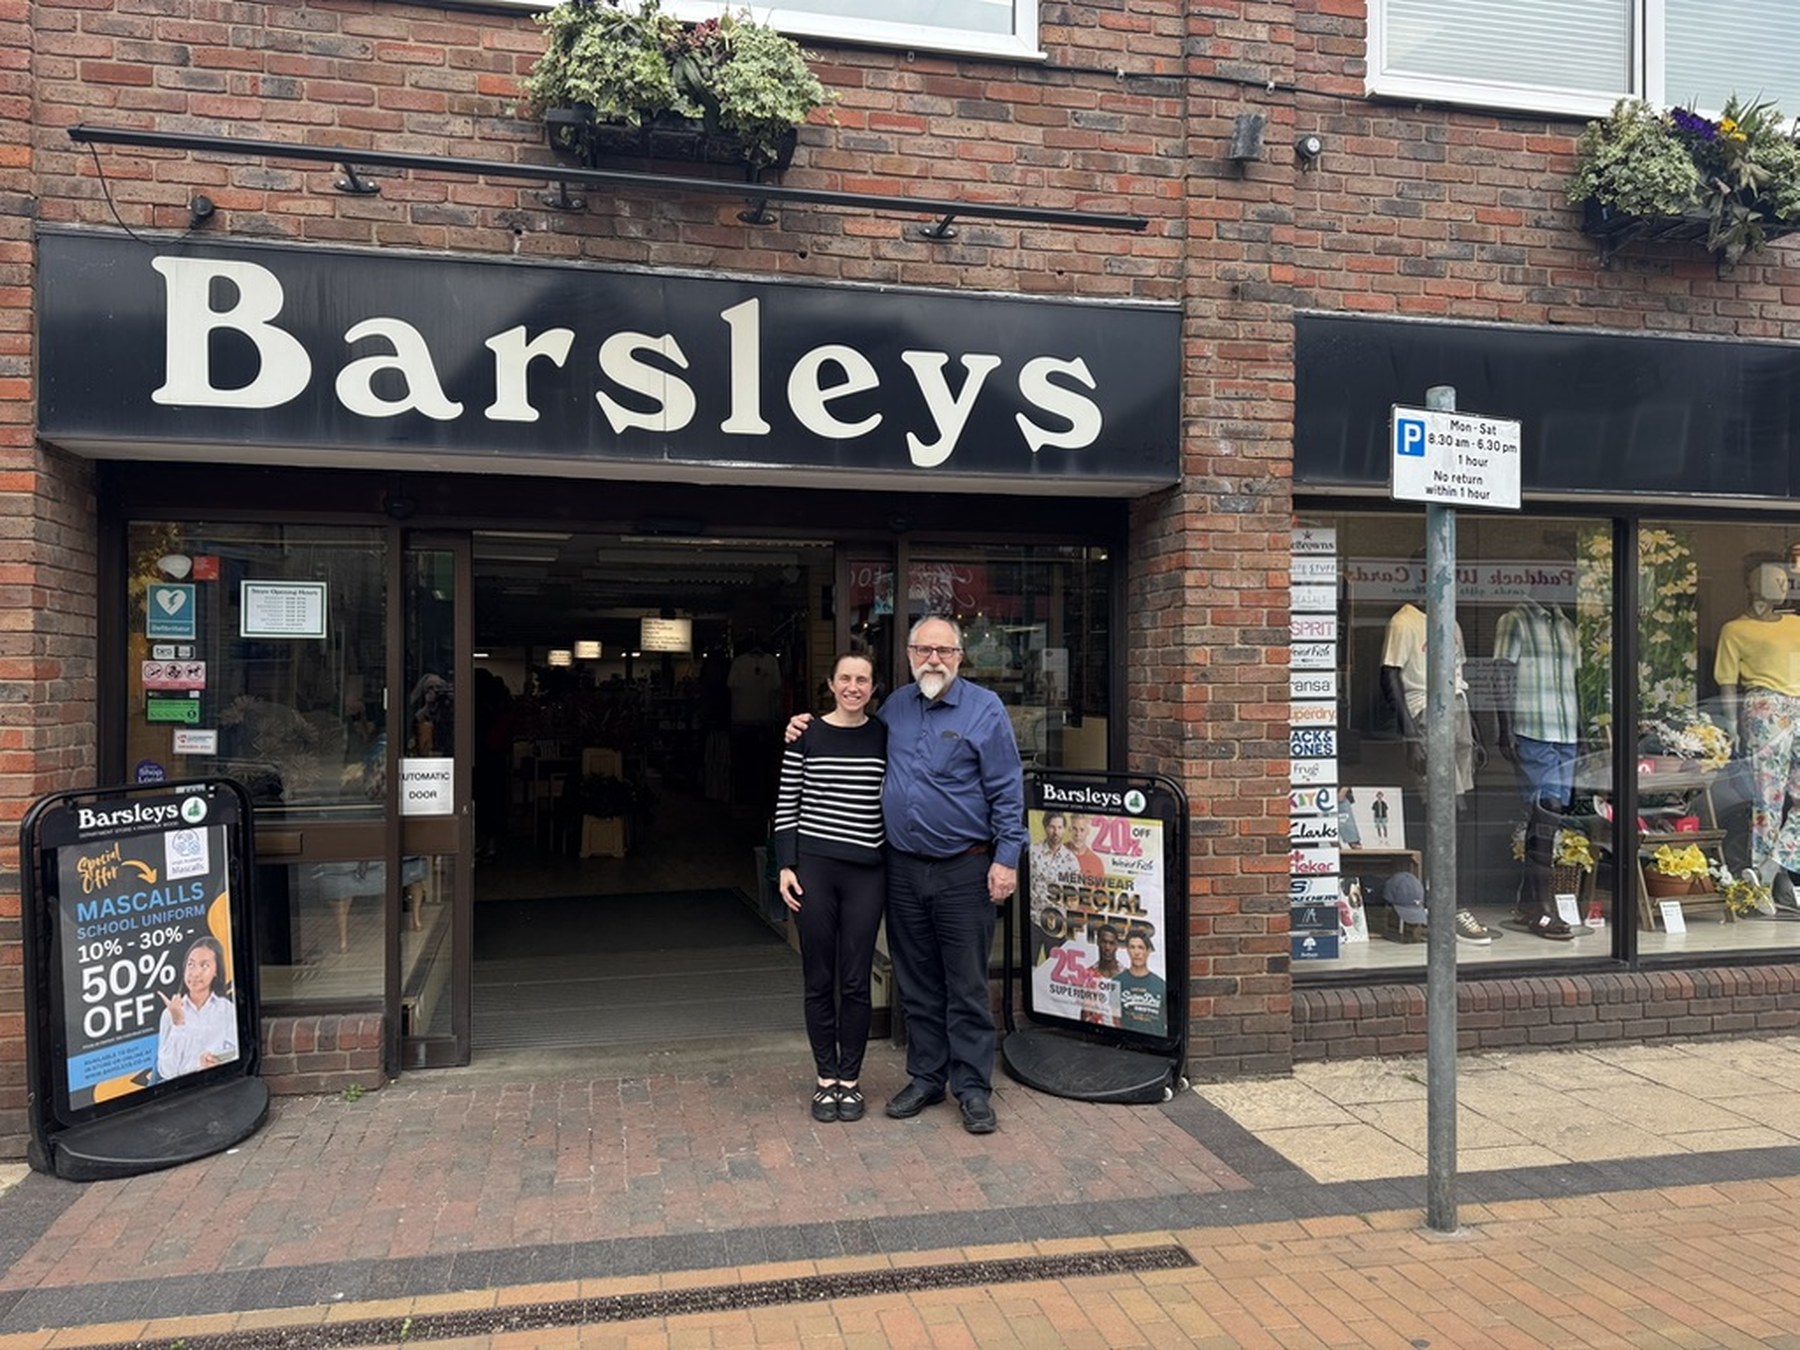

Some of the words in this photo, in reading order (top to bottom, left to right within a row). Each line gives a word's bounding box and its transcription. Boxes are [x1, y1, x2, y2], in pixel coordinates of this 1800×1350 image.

[152, 255, 1103, 468] Barsleys
[1404, 423, 1422, 453] P
[1450, 420, 1472, 432] Mon
[1479, 423, 1497, 436] Sat
[1428, 433, 1453, 446] 8.30
[1455, 440, 1470, 448] am
[1477, 439, 1500, 452] 6.30
[1502, 444, 1518, 454] pm
[1457, 455, 1463, 464] 1
[1465, 456, 1489, 467] hour
[1433, 470, 1449, 482] No
[1451, 473, 1483, 485] return
[1425, 485, 1457, 497] within
[1460, 487, 1465, 496] 1
[1467, 488, 1490, 500] hour
[1291, 621, 1334, 636] SPRIT
[1291, 730, 1333, 742] ACK&
[1291, 743, 1333, 756] ONES
[401, 771, 451, 781] UTOMATIC
[408, 790, 437, 799] DOOR
[1043, 783, 1122, 807] Barsleys
[78, 803, 179, 829] Barsleys
[1091, 815, 1143, 857] 20%
[1132, 827, 1151, 838] OFF
[76, 842, 122, 876] Special
[81, 865, 120, 894] Offer
[1058, 871, 1134, 891] MENSWEAR
[77, 882, 205, 922] MASCALLS
[1046, 883, 1148, 917] SPECIAL
[77, 918, 138, 940] SCHOOL
[141, 904, 205, 927] UNIFORM
[78, 938, 123, 964] 10%
[140, 925, 183, 950] 30%
[82, 951, 176, 1004] 50%
[1050, 946, 1097, 990] 25%
[1098, 981, 1116, 992] OFF
[83, 993, 155, 1038] OFF
